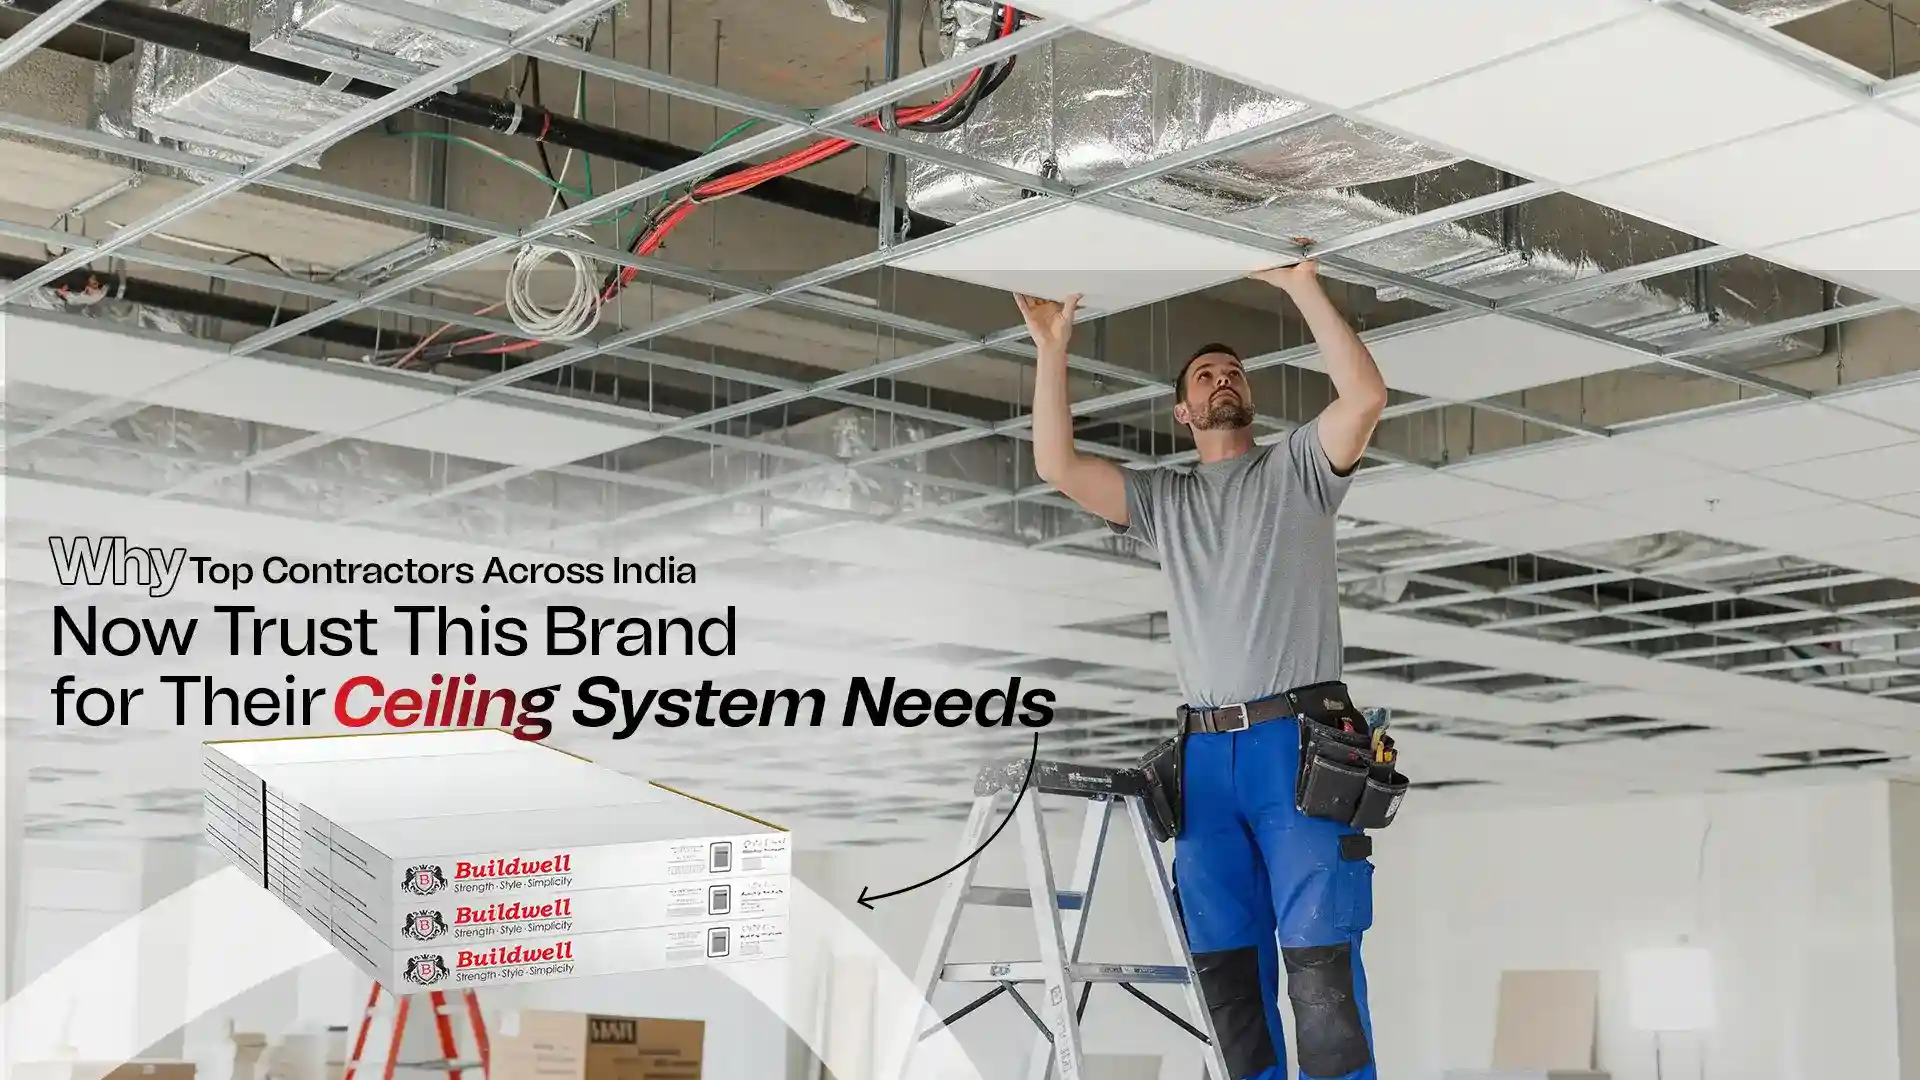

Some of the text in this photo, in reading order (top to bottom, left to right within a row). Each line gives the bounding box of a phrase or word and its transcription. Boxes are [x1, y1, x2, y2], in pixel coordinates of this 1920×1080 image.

[454, 854, 572, 879] Buildwell
[454, 876, 573, 894] Strength Style Simplicity
[454, 898, 572, 924] Buildwell
[454, 921, 573, 939] Strength Style Simplicity
[456, 941, 574, 968] Buildwell
[456, 964, 574, 983] Strength Style Simplicity
